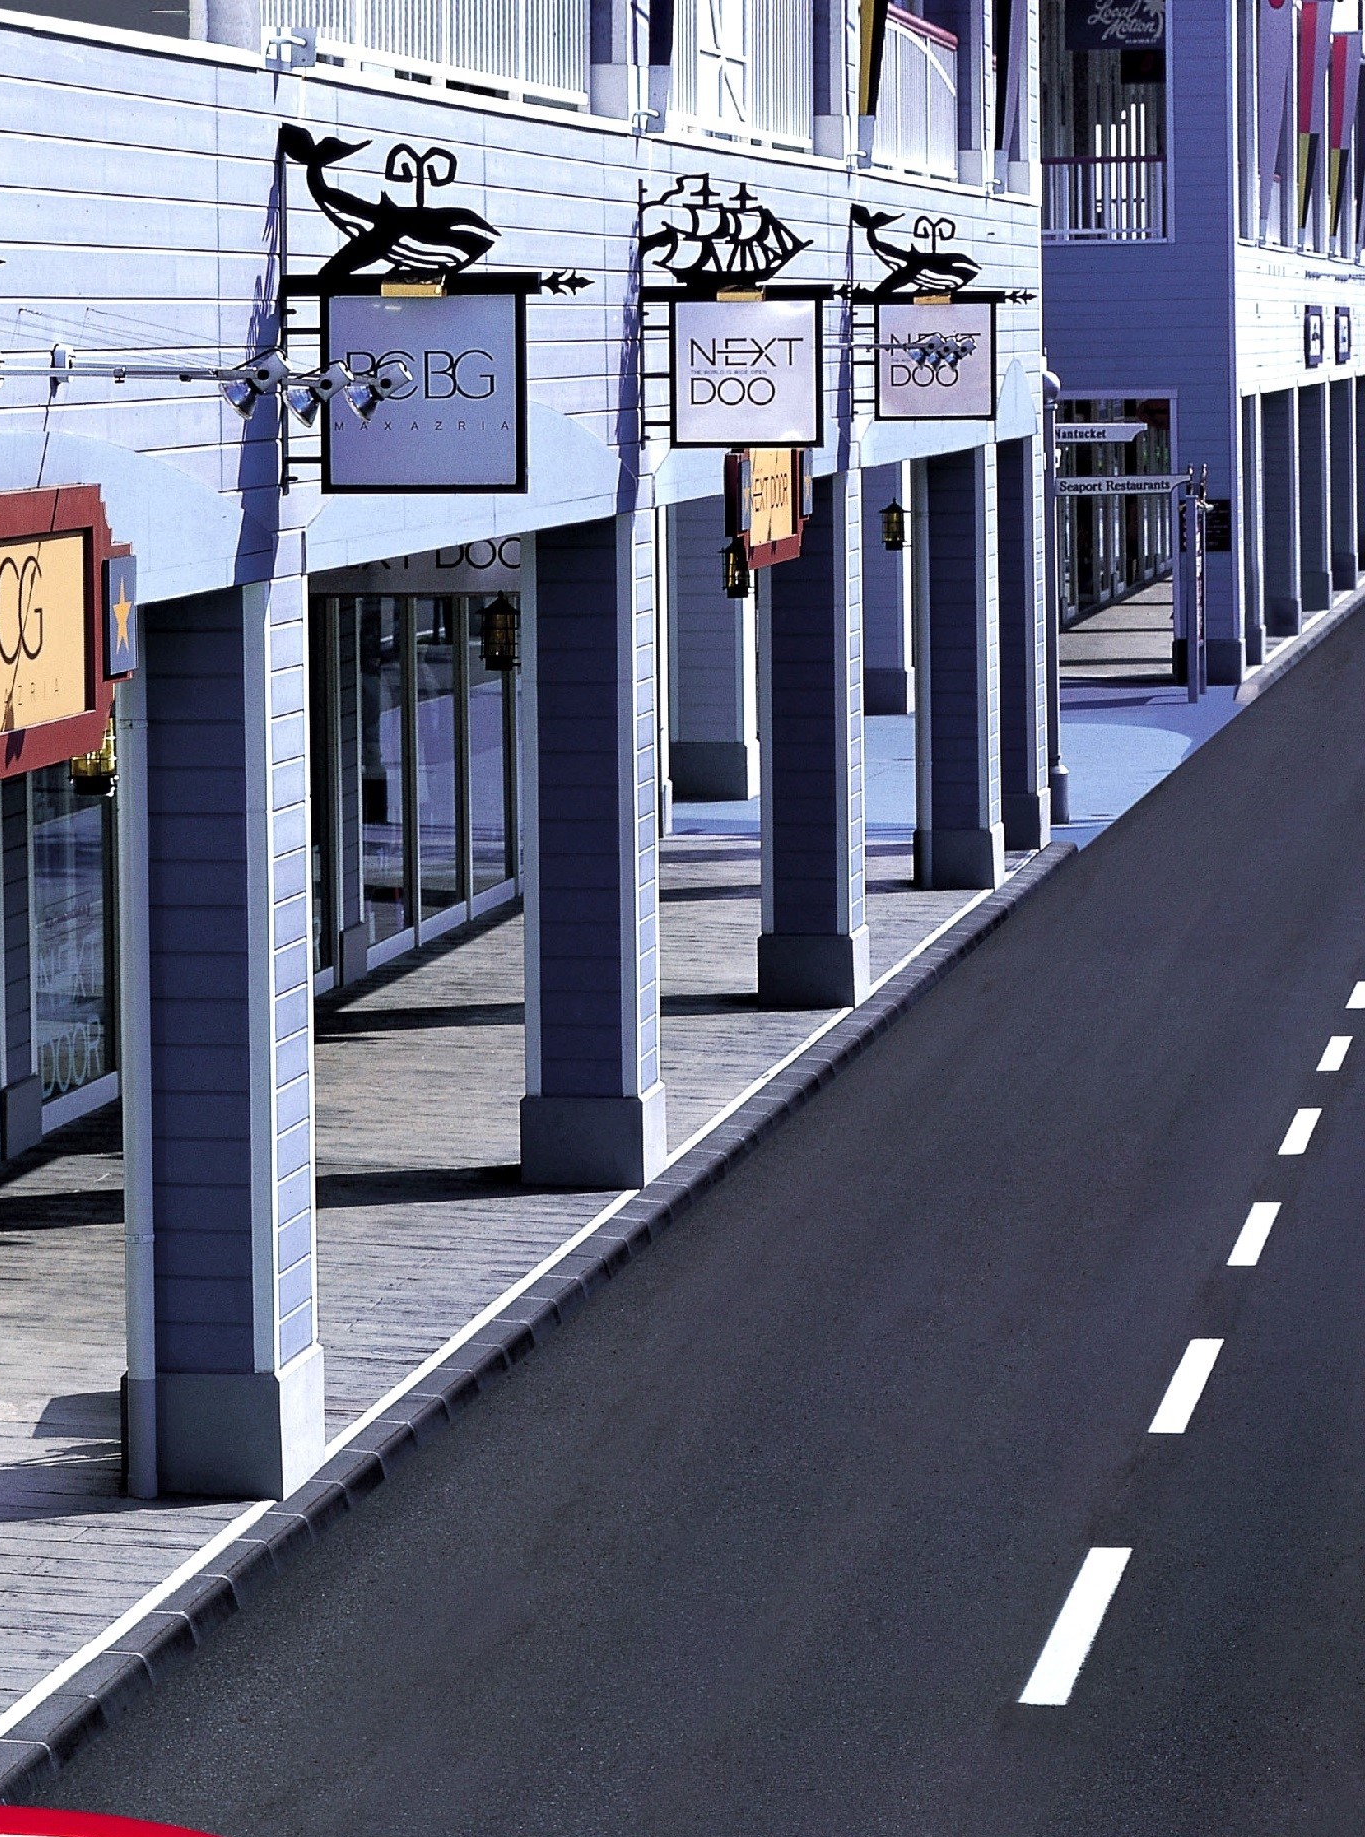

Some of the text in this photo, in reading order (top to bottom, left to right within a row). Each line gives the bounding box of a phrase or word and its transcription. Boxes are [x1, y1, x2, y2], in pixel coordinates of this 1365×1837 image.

[690, 337, 804, 366] NEXT
[690, 377, 776, 405] DOO
[1059, 480, 1170, 493] Seaport Restaurants
